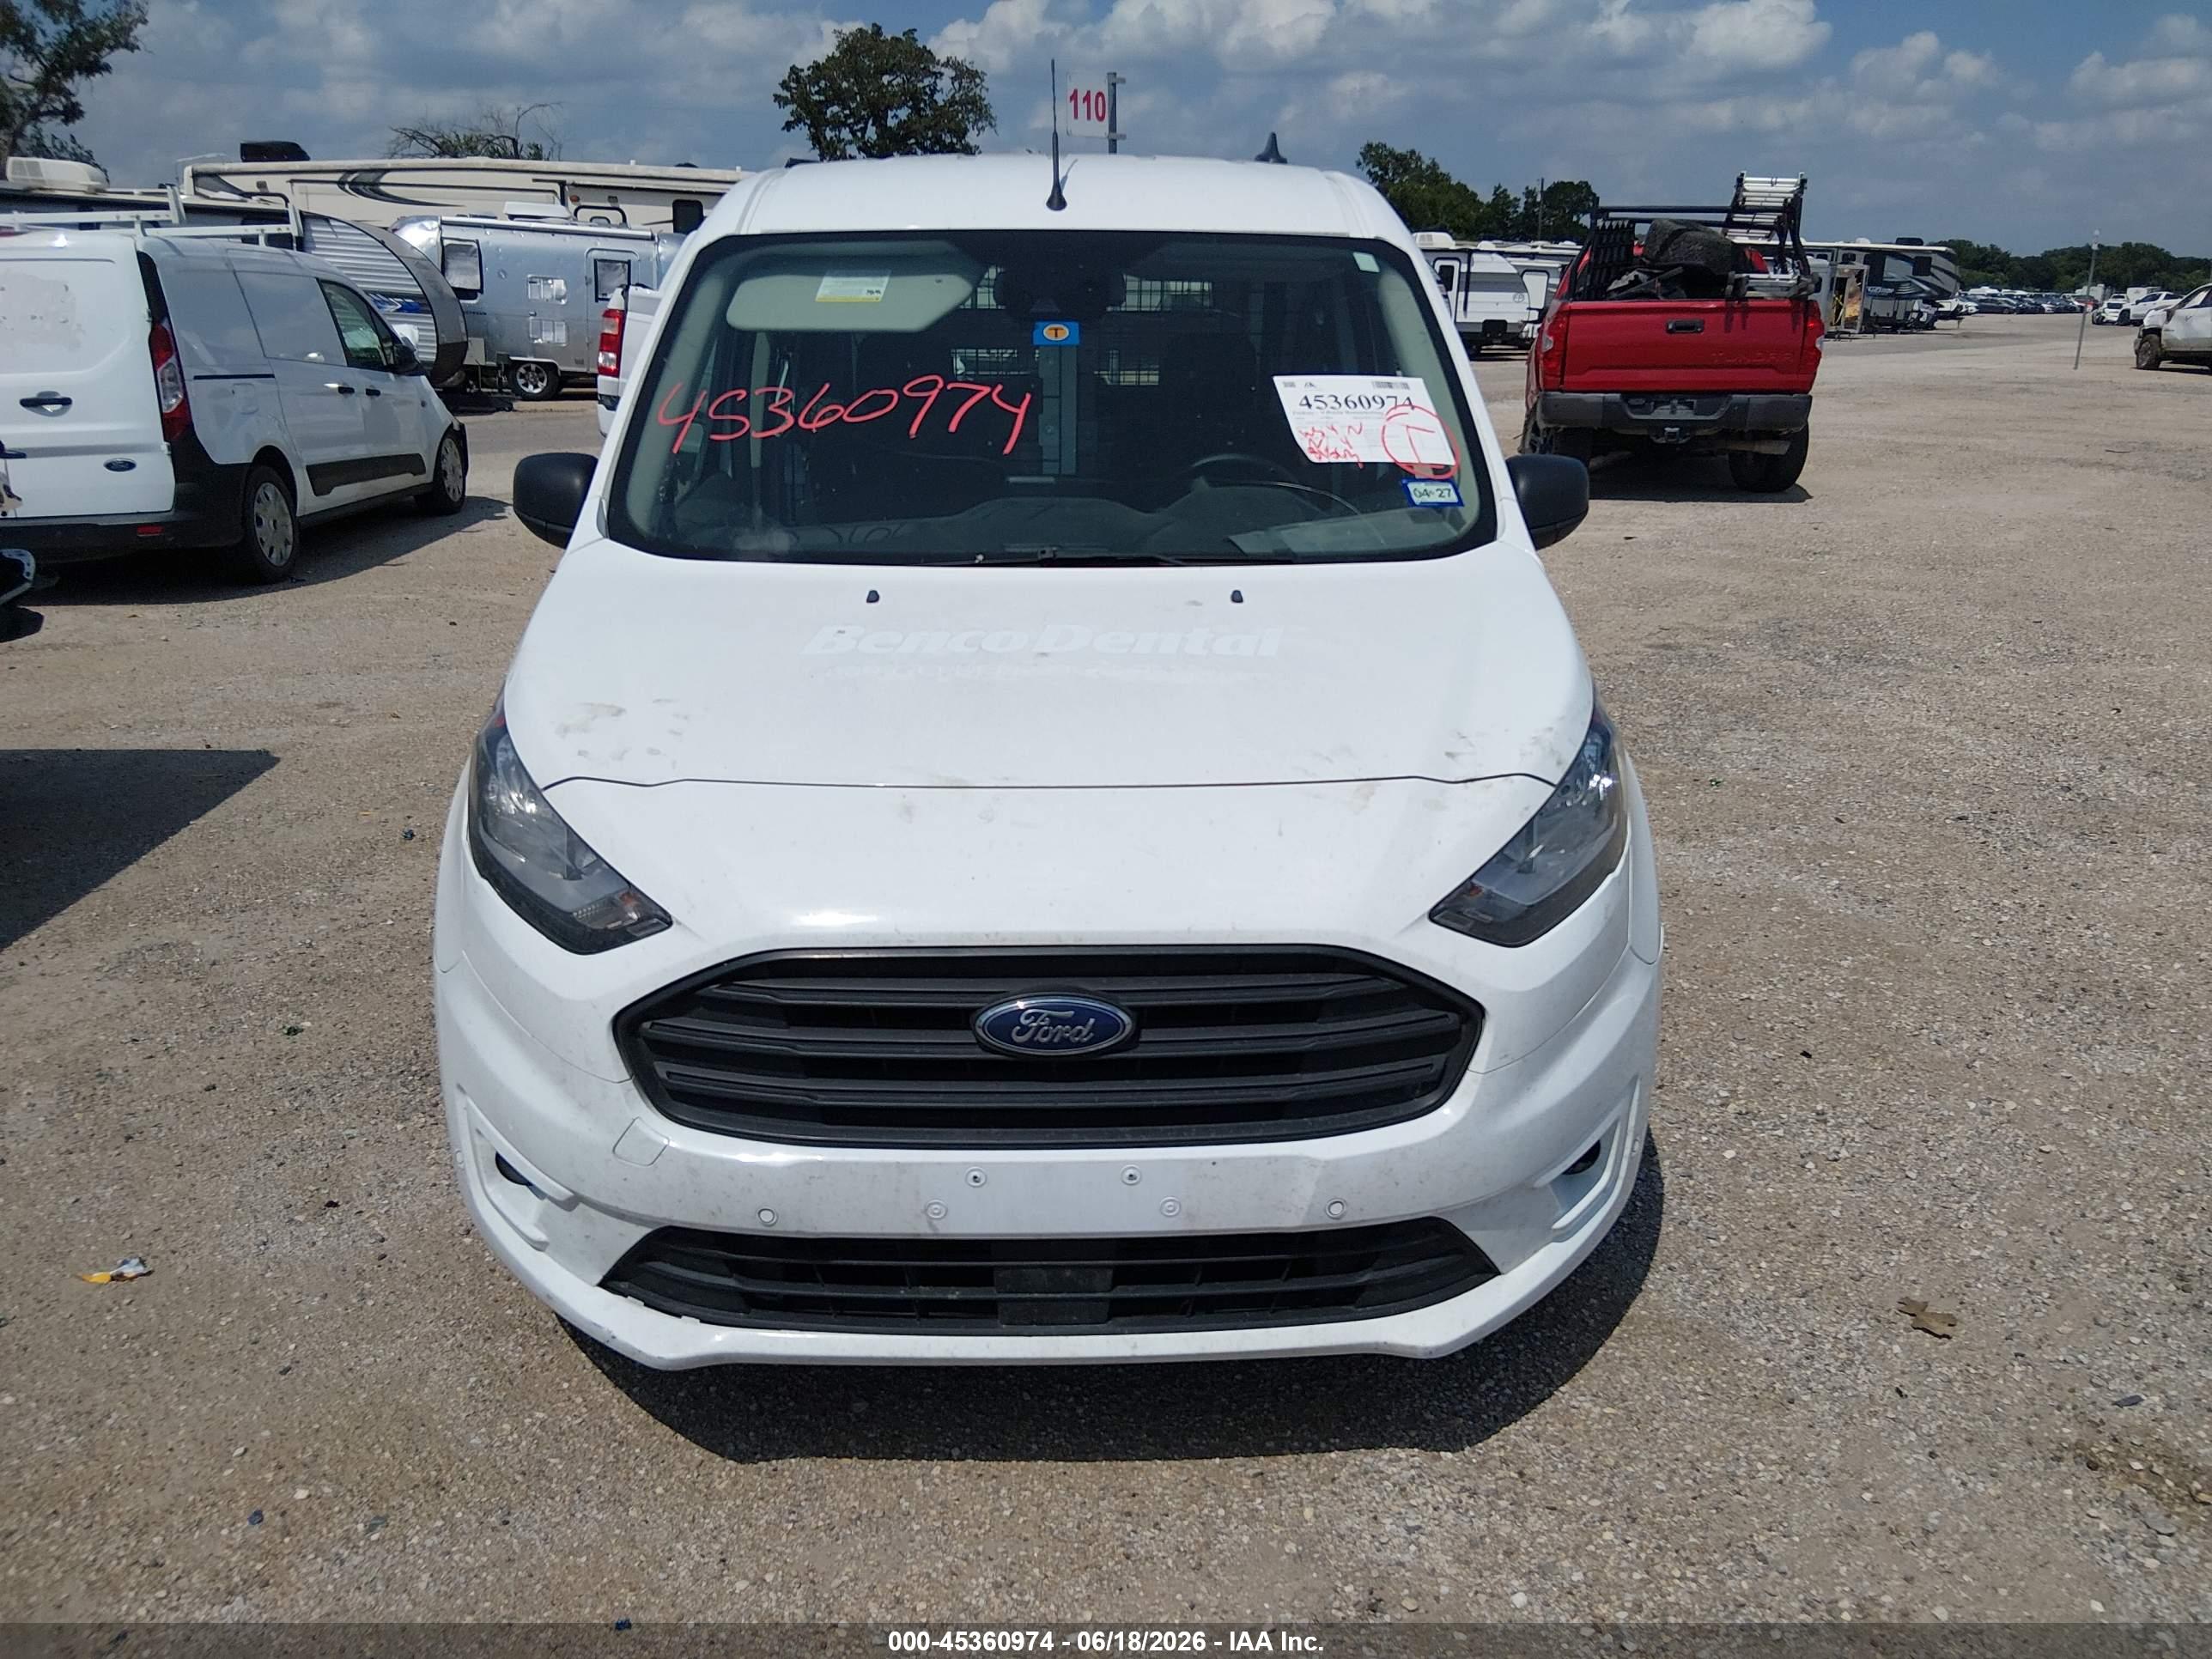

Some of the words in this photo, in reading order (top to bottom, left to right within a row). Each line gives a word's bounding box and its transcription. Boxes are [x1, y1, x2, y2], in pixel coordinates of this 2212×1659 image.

[1069, 88, 1107, 122] 110
[656, 374, 1032, 455] 45360974
[1298, 393, 1415, 411] 45360974
[1011, 1008, 1096, 1043] Ford
